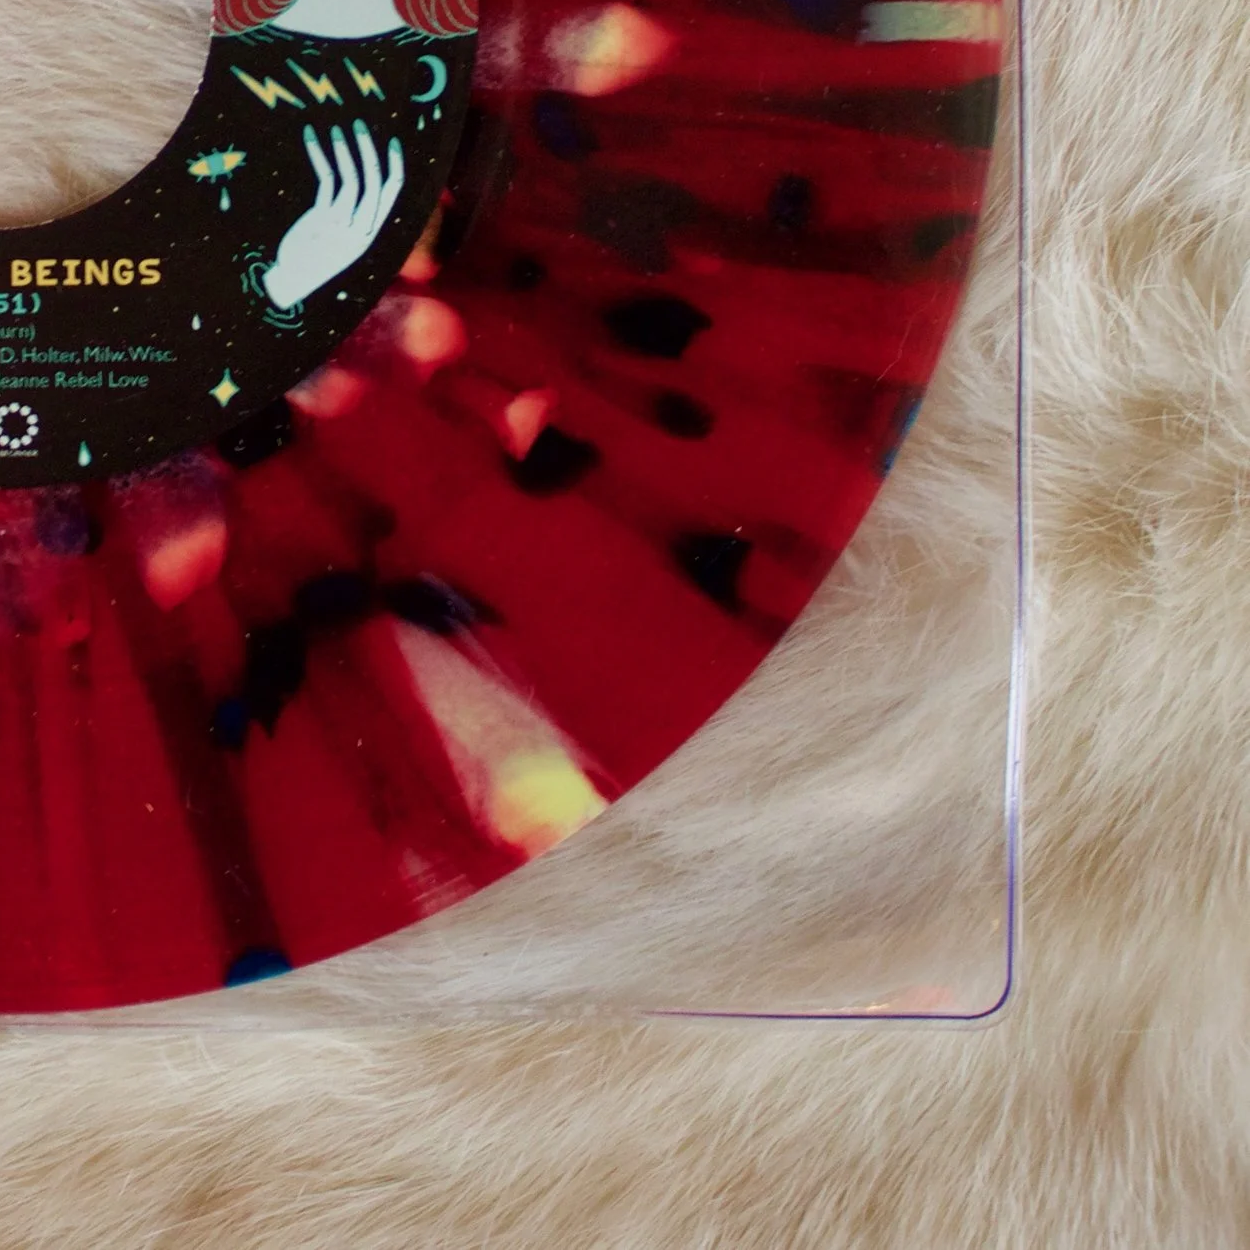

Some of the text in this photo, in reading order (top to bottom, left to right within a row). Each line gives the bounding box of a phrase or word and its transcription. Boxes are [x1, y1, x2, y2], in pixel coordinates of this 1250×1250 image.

[10, 258, 161, 287] BEINGS
[54, 371, 103, 388] Rebel
[108, 371, 149, 388] Love
